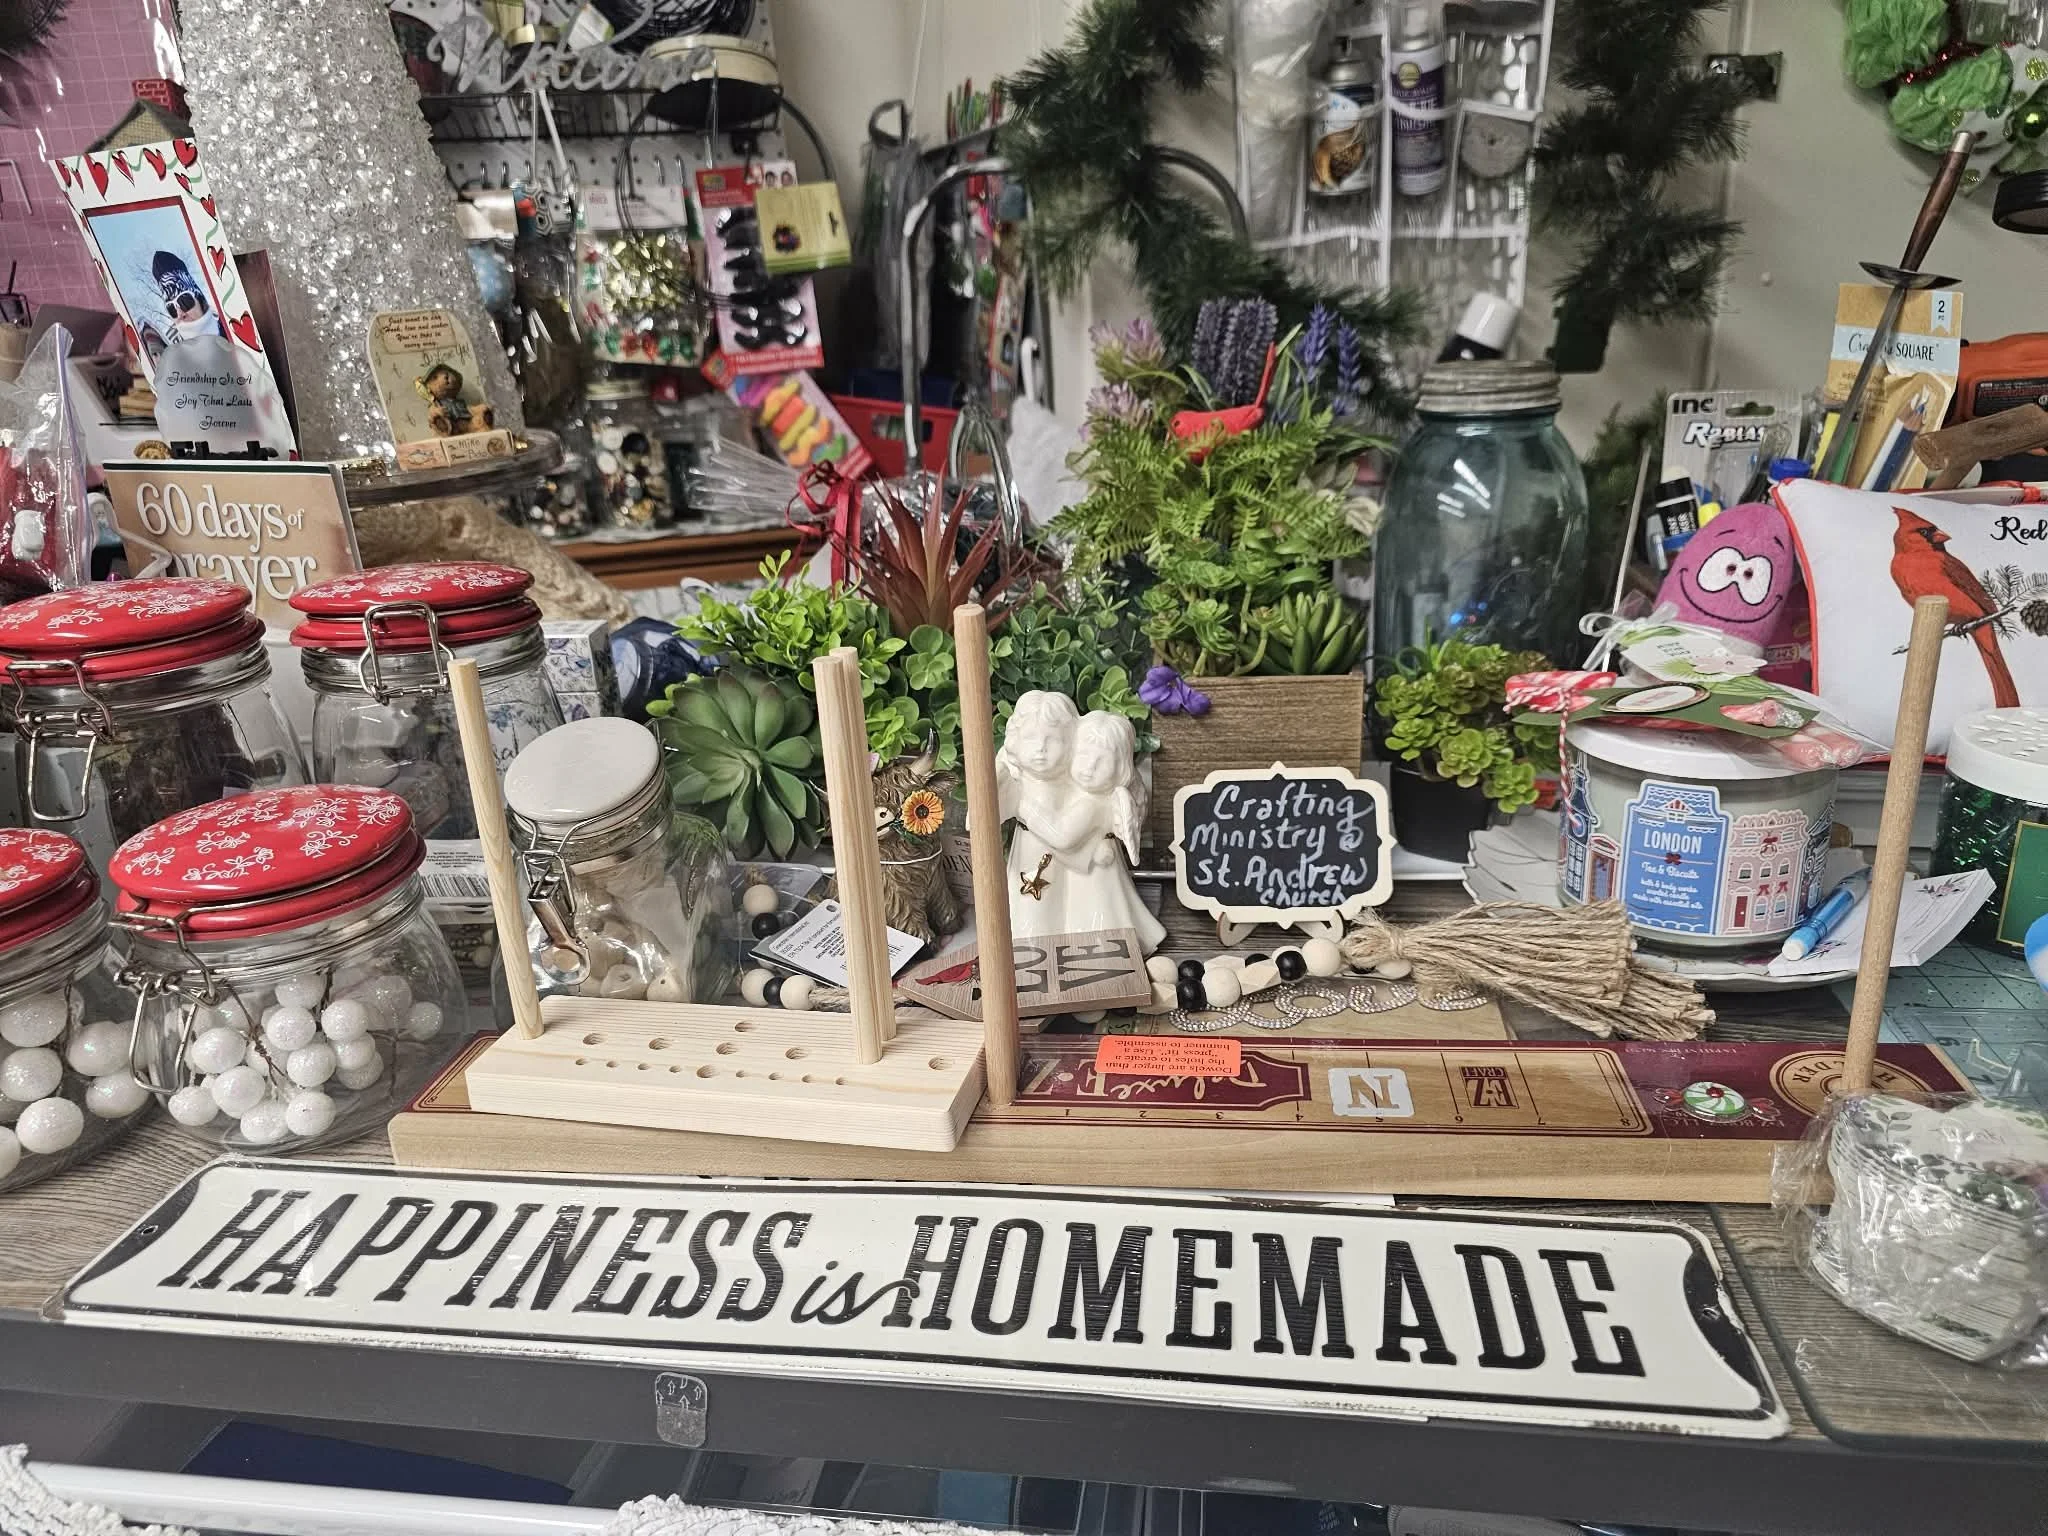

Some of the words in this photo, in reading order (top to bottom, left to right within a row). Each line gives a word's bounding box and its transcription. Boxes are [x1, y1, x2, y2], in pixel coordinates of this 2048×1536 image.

[1937, 300, 1946, 314] 2
[1896, 342, 1935, 362] SQUARE
[166, 371, 217, 388] Friendship
[175, 392, 198, 410] Joy
[199, 393, 224, 407] That
[199, 415, 237, 431] Forever
[136, 482, 193, 537] 60
[196, 484, 288, 553] days
[287, 508, 305, 530] of
[1989, 516, 2048, 546] Red
[1213, 781, 1375, 833] Crafting
[1189, 818, 1326, 865] Ministry
[1338, 826, 1365, 853] @
[1643, 828, 1702, 854] LONDON
[1193, 853, 1240, 888] St.
[1243, 854, 1368, 893] Andrew
[1641, 861, 1658, 873] Tea
[1114, 1039, 1168, 1047] assemble.
[1184, 1042, 1230, 1050] hammer
[1105, 1062, 1129, 1070] than
[1132, 1063, 1164, 1071] larger
[1175, 1056, 1204, 1064] holes
[1189, 1065, 1233, 1074] Dowels
[1462, 1066, 1508, 1078] CRAFT
[1347, 1073, 1401, 1110] N
[157, 1189, 812, 1322] HAPPINESS
[790, 1259, 922, 1326] is
[881, 1215, 1646, 1377] HOMEMADE
